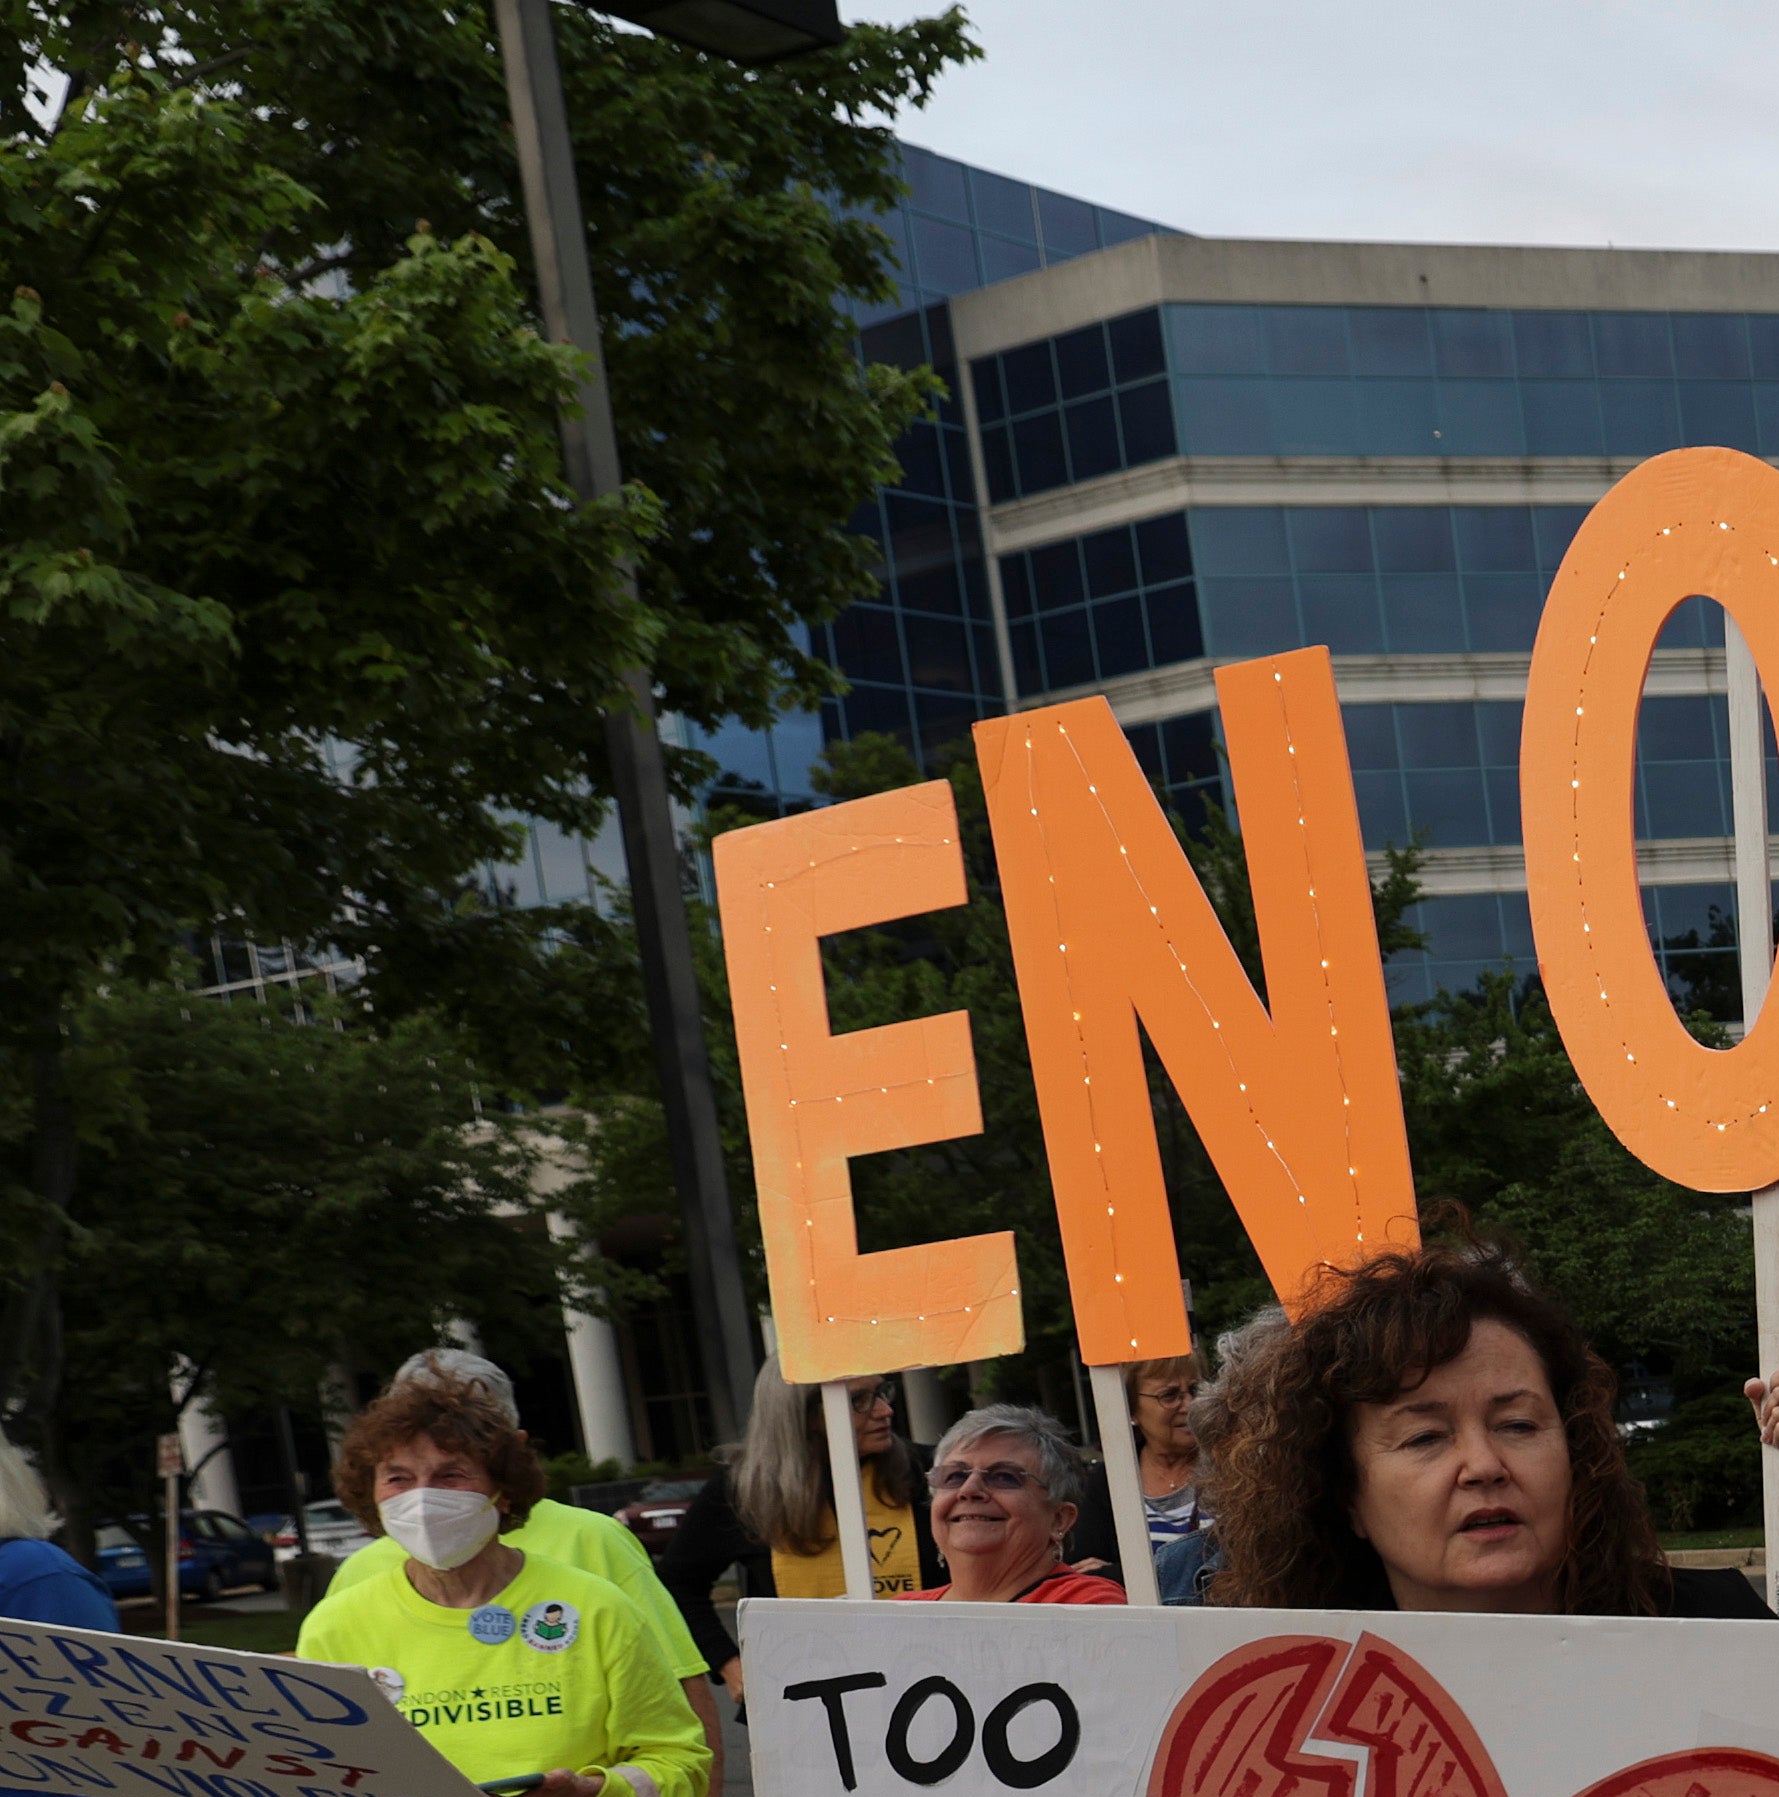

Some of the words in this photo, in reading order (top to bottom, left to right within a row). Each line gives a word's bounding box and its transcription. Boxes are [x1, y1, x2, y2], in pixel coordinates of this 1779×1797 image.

[873, 1579, 914, 1593] OVE
[471, 1612, 512, 1624] VOTE
[473, 1623, 511, 1636] BLUE
[0, 1631, 368, 1725] ERNED
[490, 1681, 561, 1698] RESTON
[401, 1696, 563, 1727] DIVISIBLE
[783, 1671, 1081, 1793] TOO
[0, 1719, 380, 1788] GAINST
[0, 1750, 117, 1788] UN
